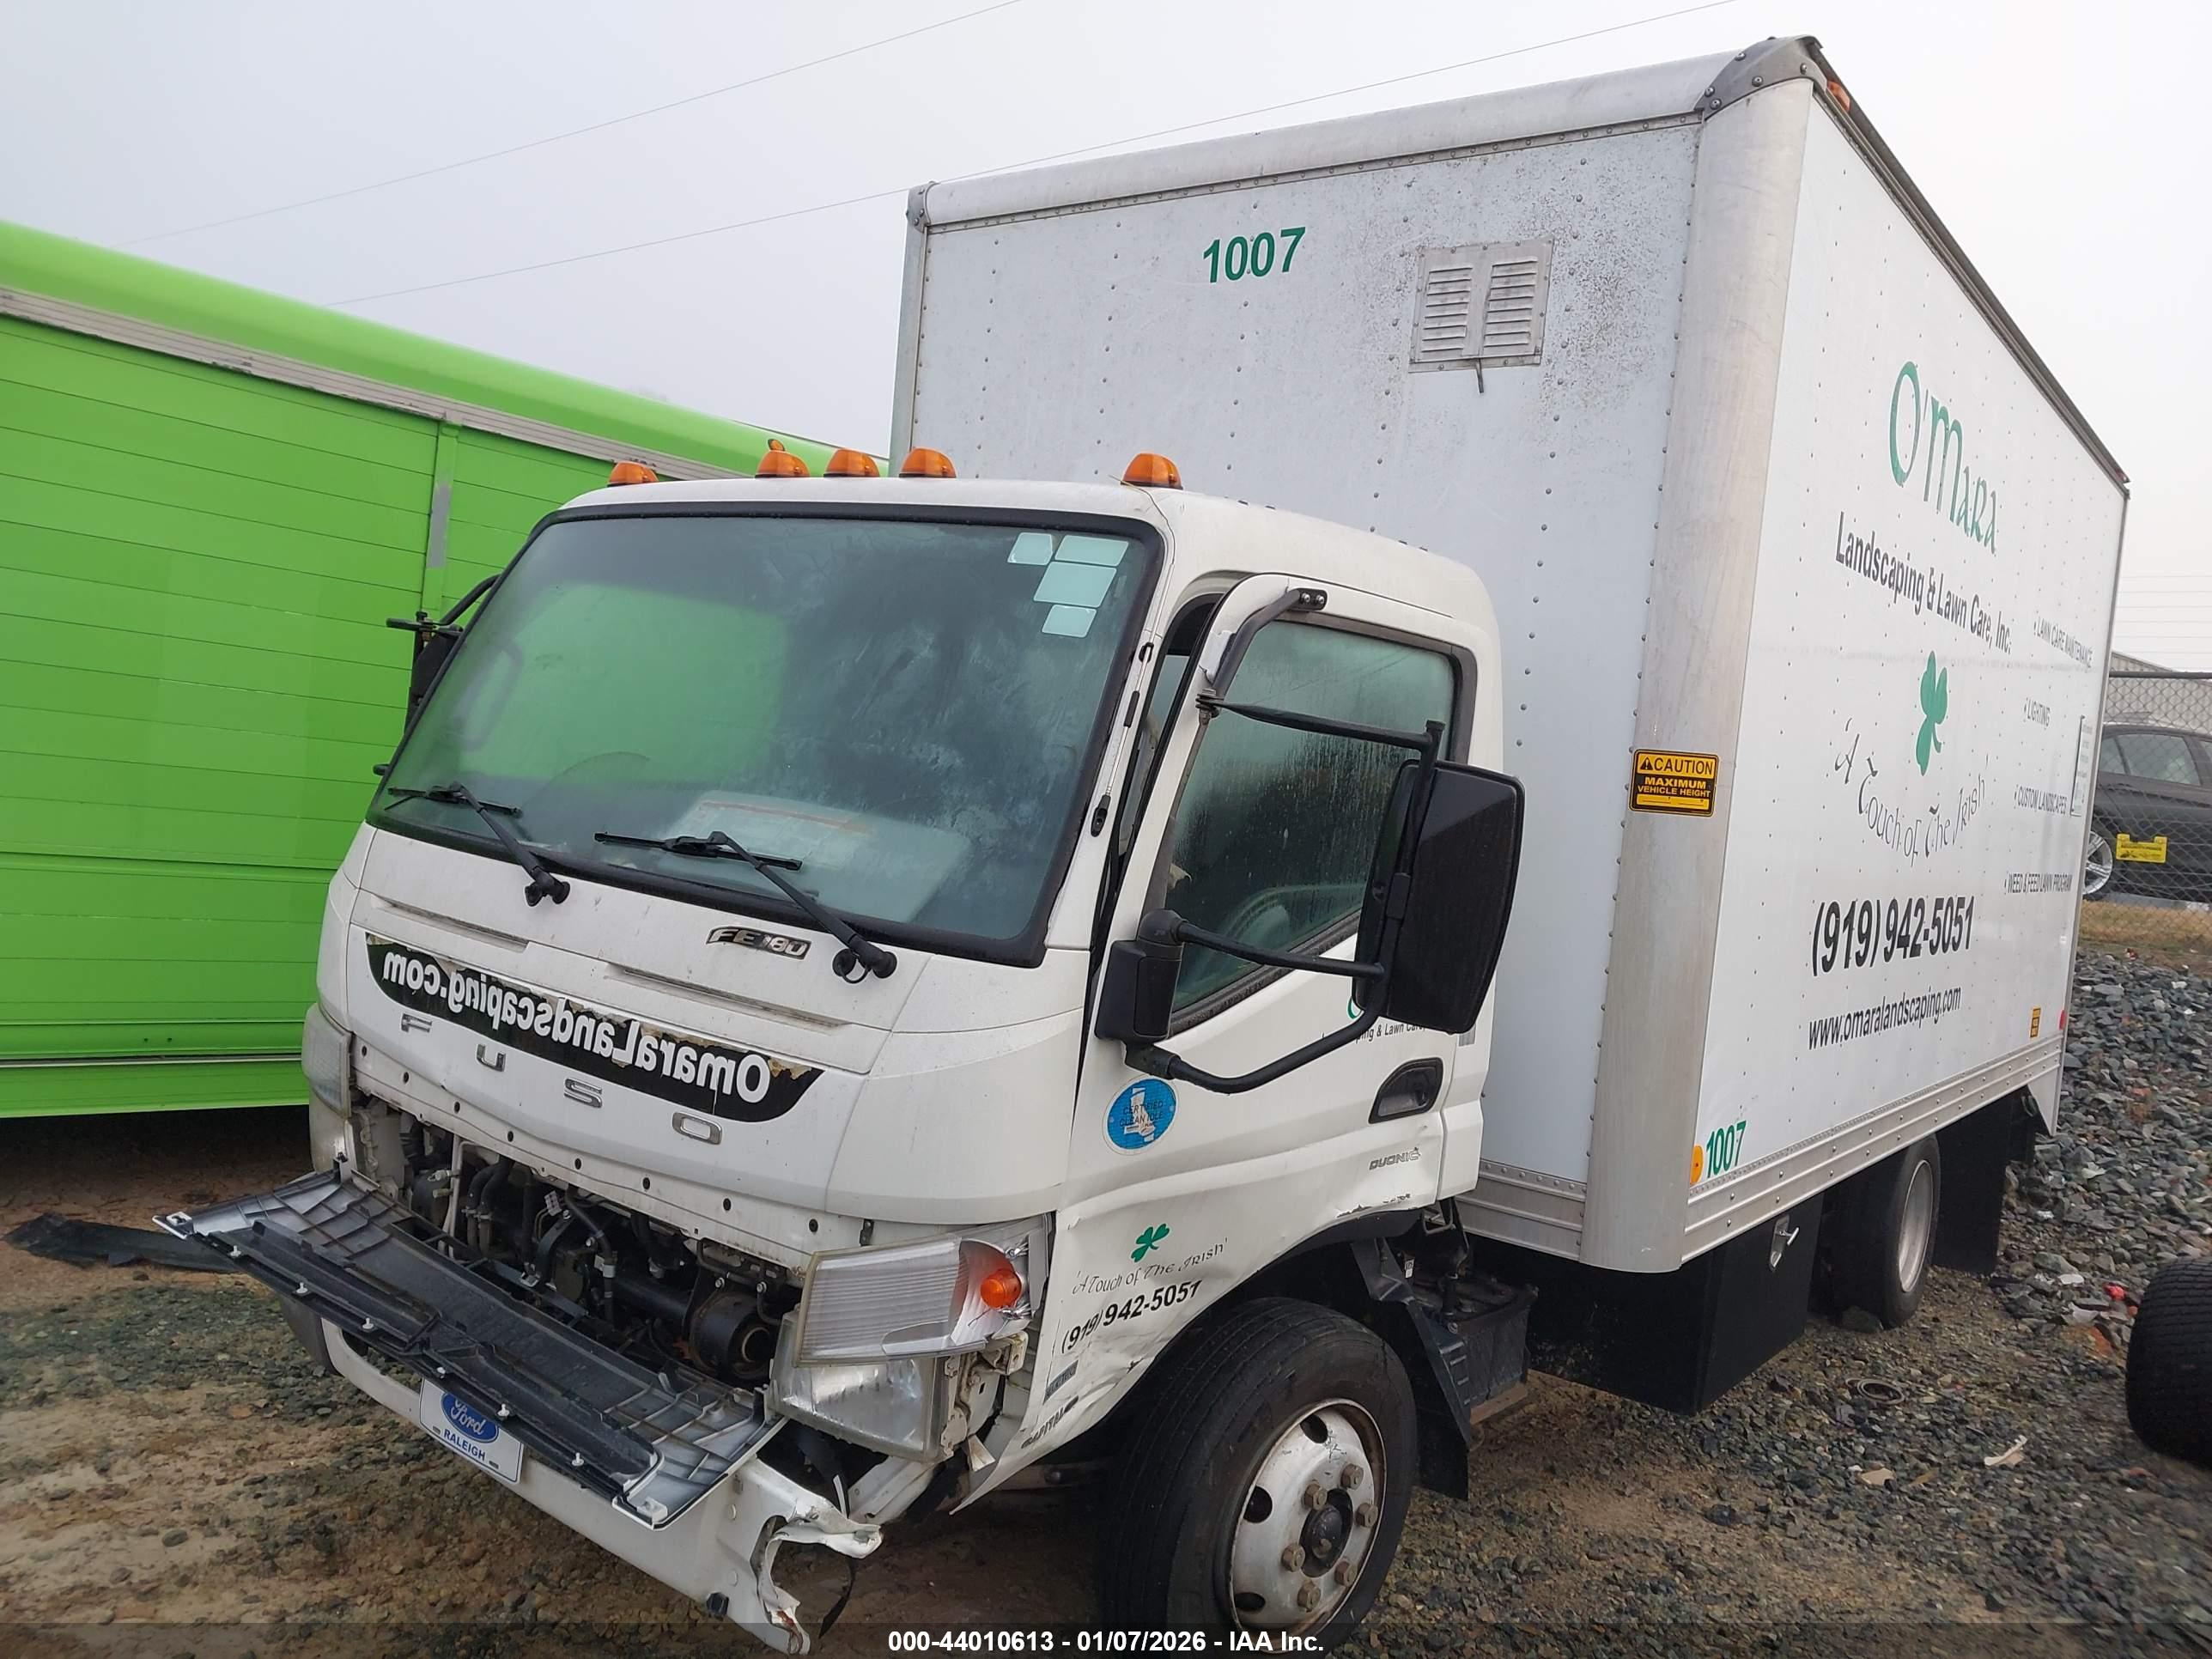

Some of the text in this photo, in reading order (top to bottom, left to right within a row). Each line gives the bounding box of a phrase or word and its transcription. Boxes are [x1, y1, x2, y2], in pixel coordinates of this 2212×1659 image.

[1202, 226, 1306, 283] 1007
[1835, 511, 2012, 653] Landscaping & Lawn Care, Inc.
[1654, 757, 1713, 775] CAUTION
[1638, 785, 1711, 799] VEHICLE HEIGHT
[1644, 776, 1707, 789] MAXIMUM
[2018, 786, 2039, 809] CUSTOM
[1858, 757, 1901, 852] Touch
[1904, 818, 1923, 868] of
[1925, 803, 1951, 859] The
[2008, 872, 2023, 893] WEED
[1813, 896, 1976, 977] (919) 942-5051
[1376, 1024, 1382, 1037] &
[1384, 1023, 1404, 1036] Lawn
[1808, 986, 1962, 1050] www.omaralandscaping.com
[400, 1012, 723, 1146] FUSO
[1119, 1111, 1164, 1127] CLEAN IDLE
[1123, 1100, 1164, 1115] CERTIFIED
[1706, 1120, 1747, 1179] 1007
[1126, 1267, 1142, 1286] of
[451, 1397, 487, 1437] Ford
[443, 1428, 486, 1462] RALEIGH
